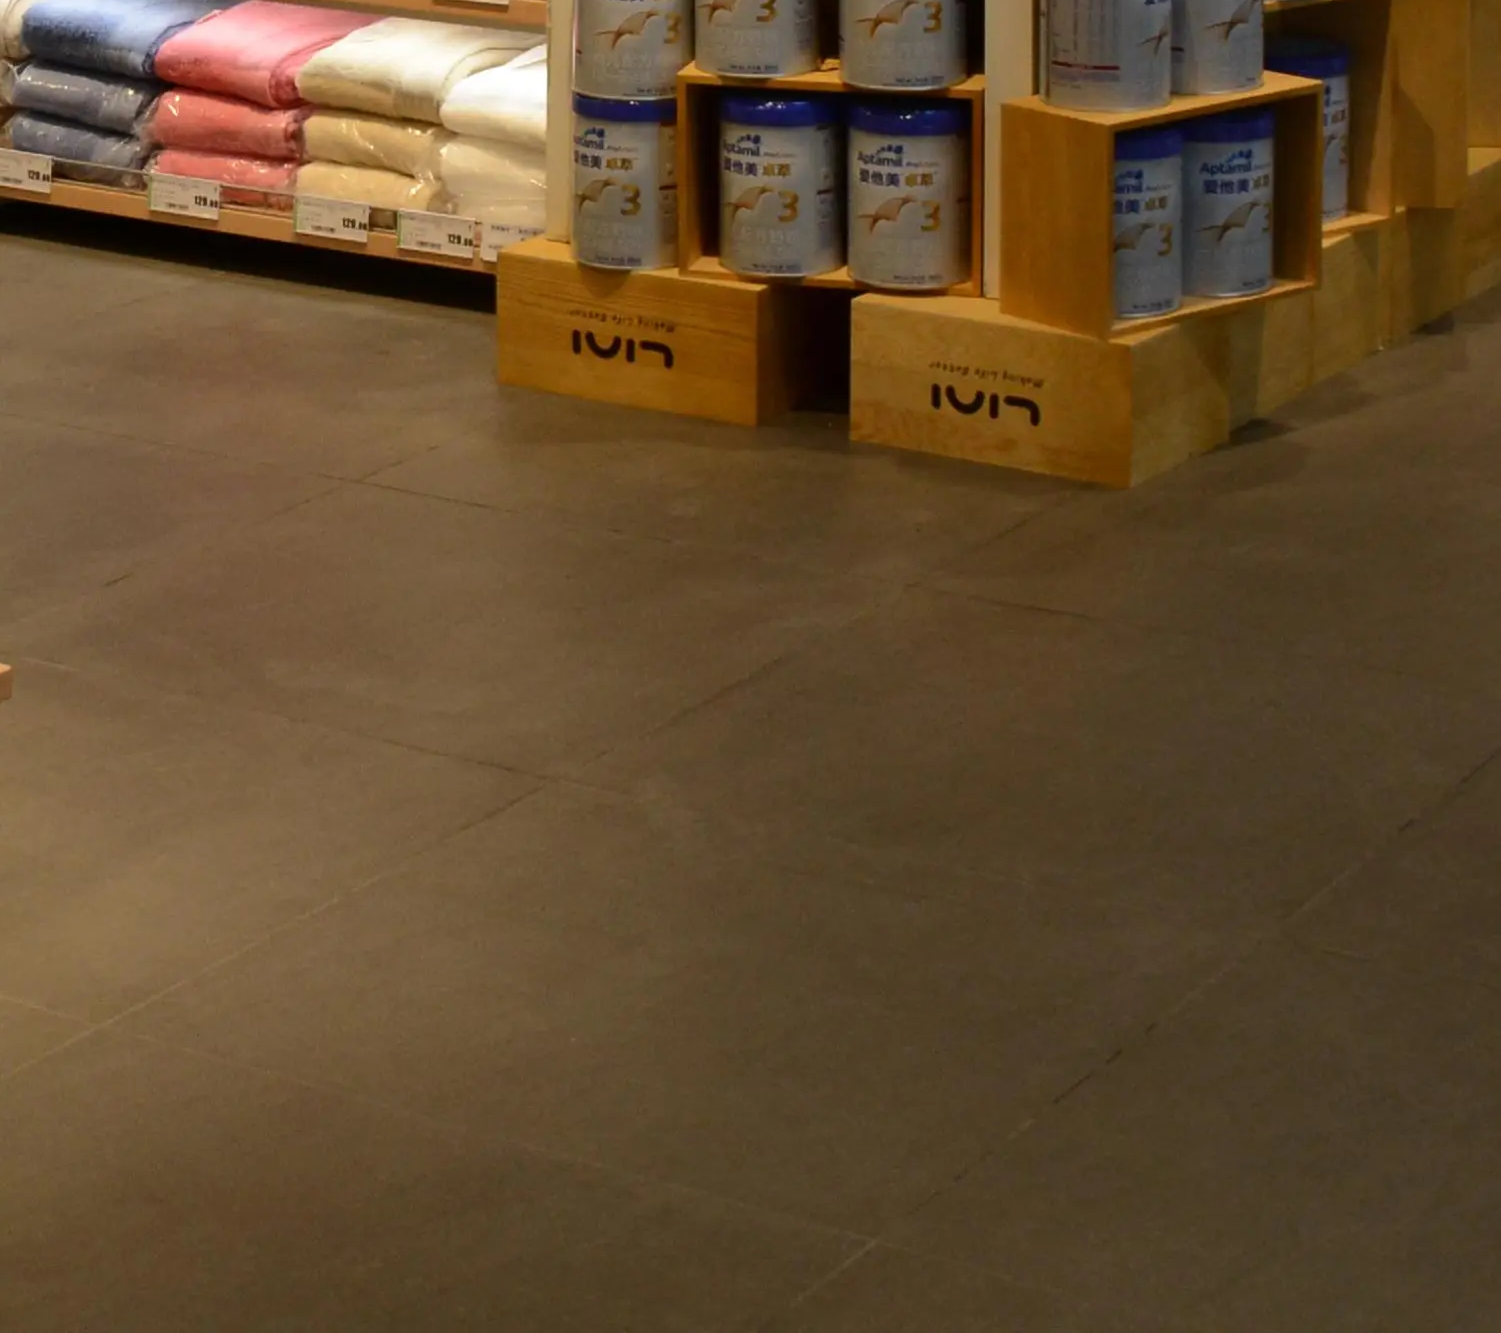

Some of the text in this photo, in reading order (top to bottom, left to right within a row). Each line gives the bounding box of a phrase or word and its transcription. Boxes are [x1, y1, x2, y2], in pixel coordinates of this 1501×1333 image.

[664, 12, 682, 45] 3
[923, 0, 944, 33] 3
[857, 150, 904, 168] Aptamil
[620, 184, 642, 217] 3
[777, 189, 800, 223] 3
[920, 199, 942, 233] 3
